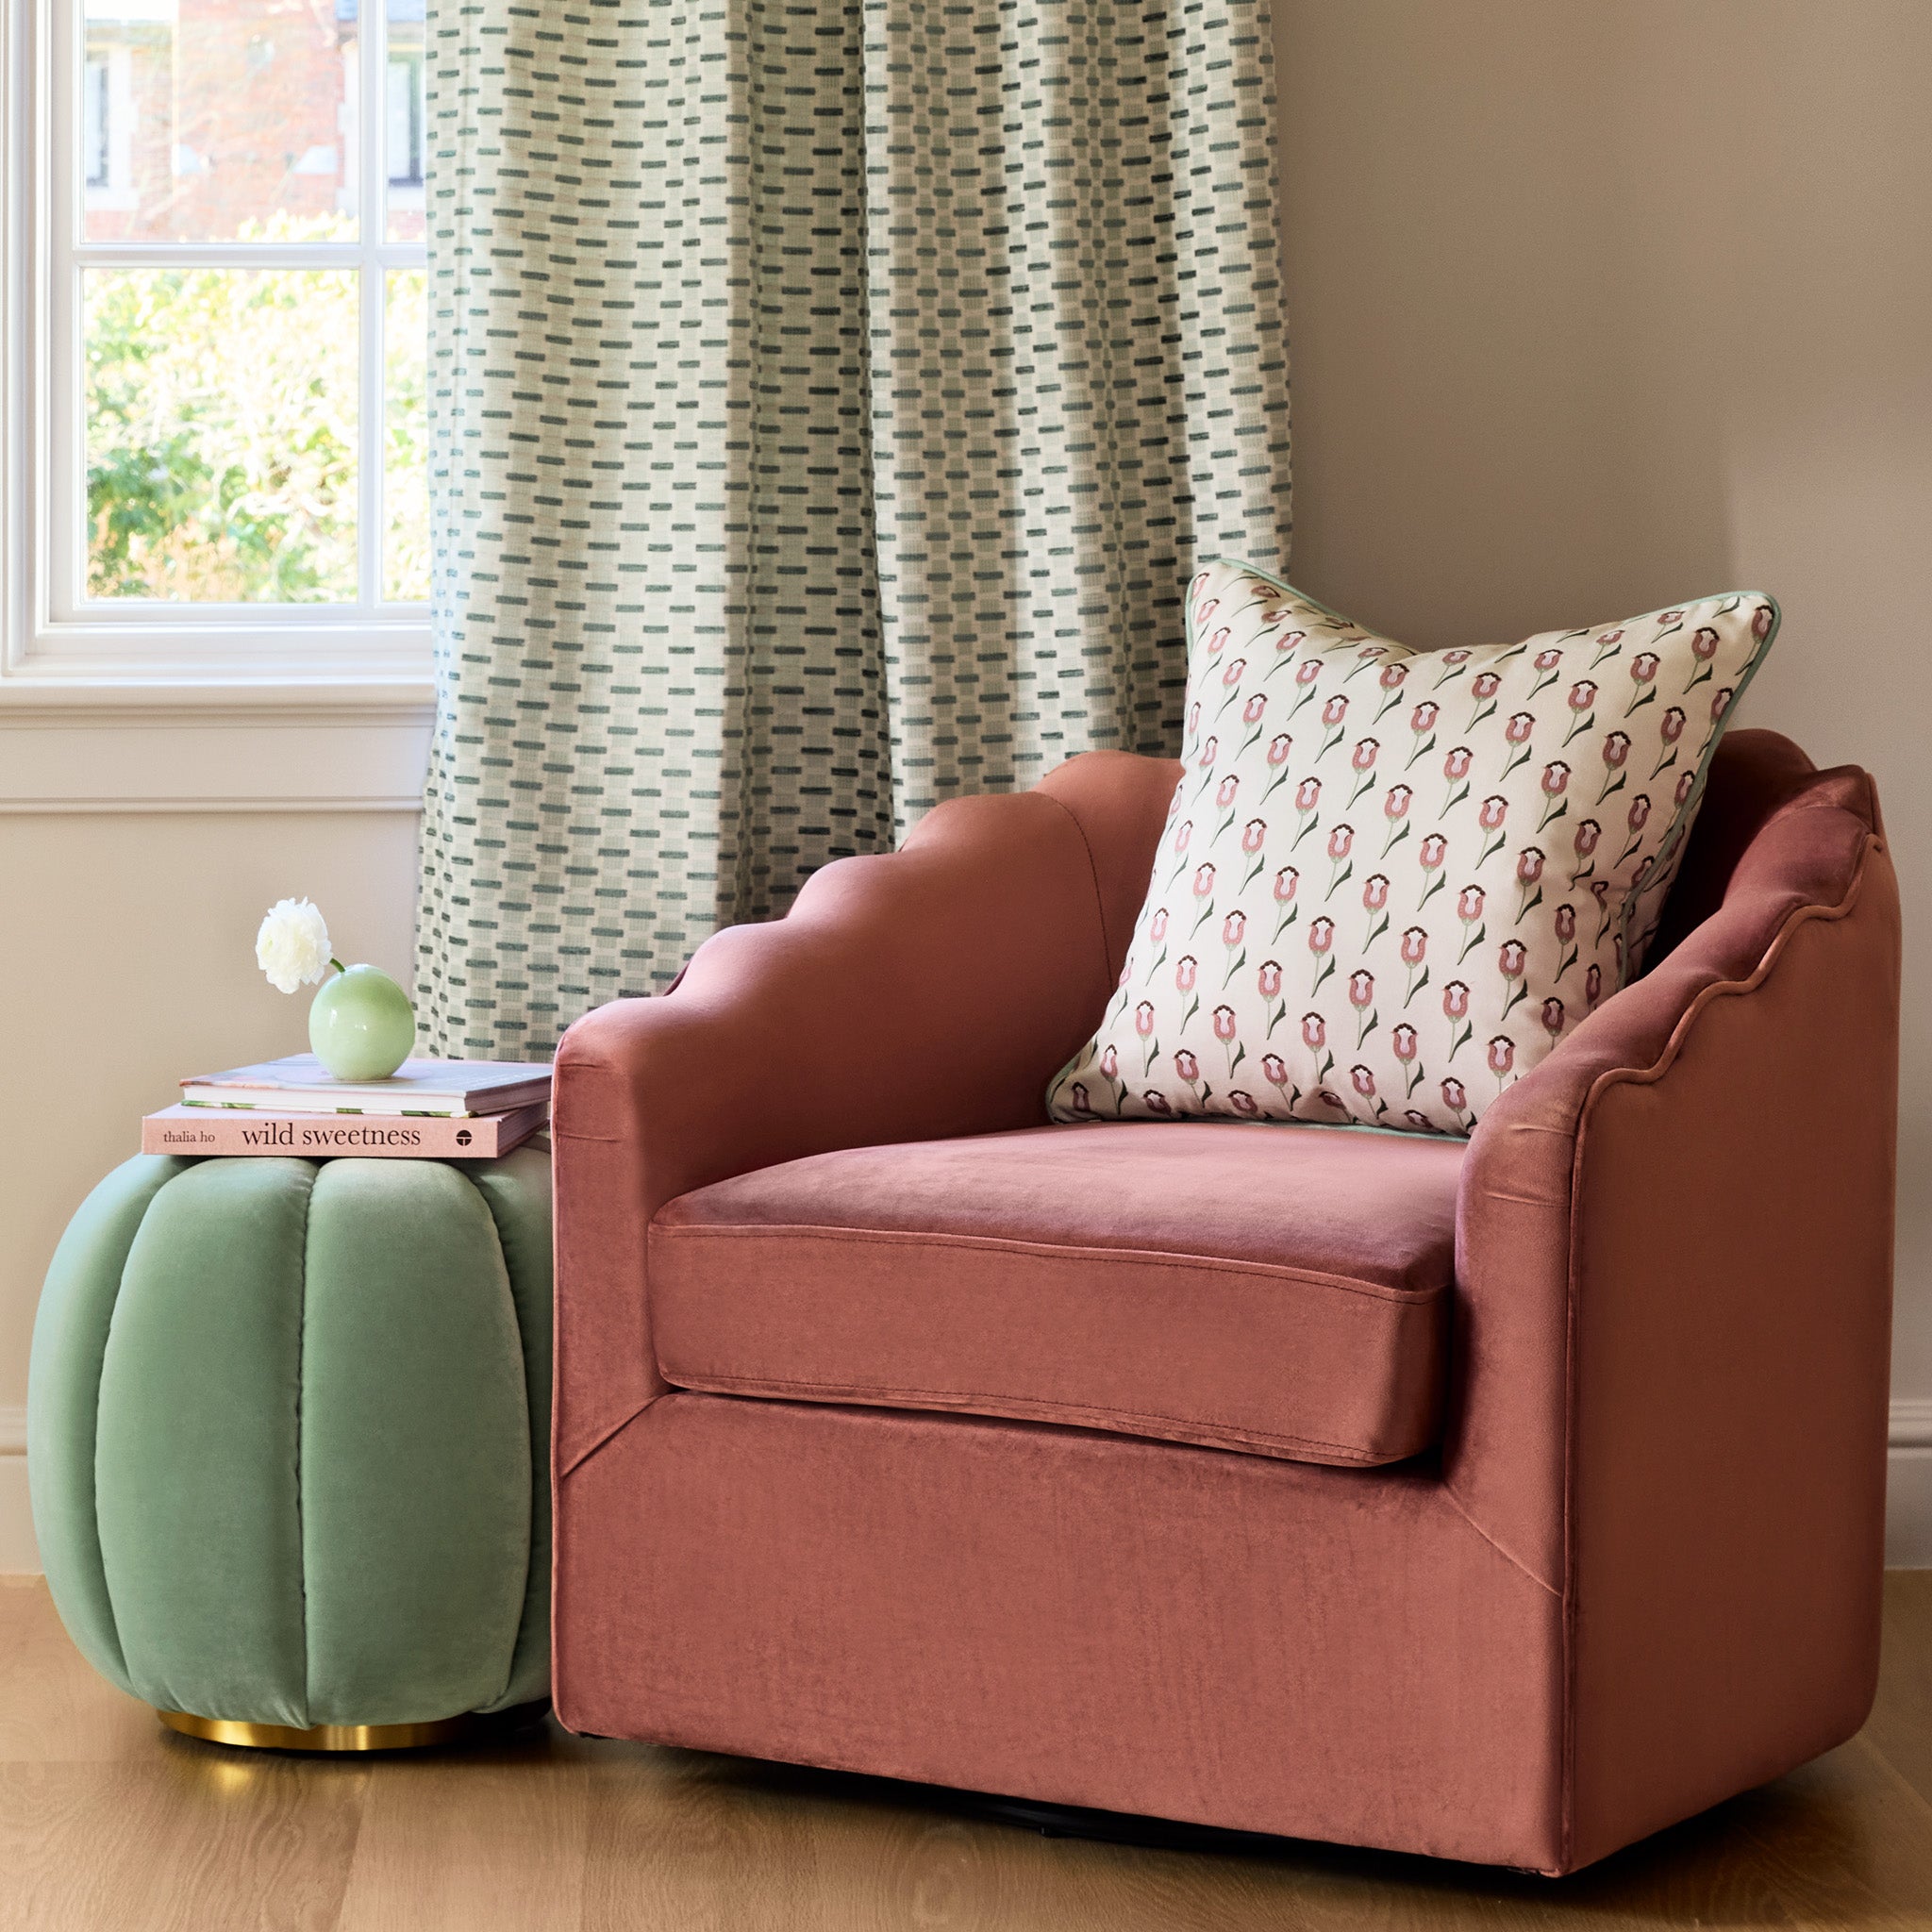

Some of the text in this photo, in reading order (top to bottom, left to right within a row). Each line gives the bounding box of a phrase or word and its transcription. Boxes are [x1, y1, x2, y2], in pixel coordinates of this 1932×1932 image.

[163, 1130, 216, 1142] thalia ho
[242, 1122, 421, 1145] wild sweetness
